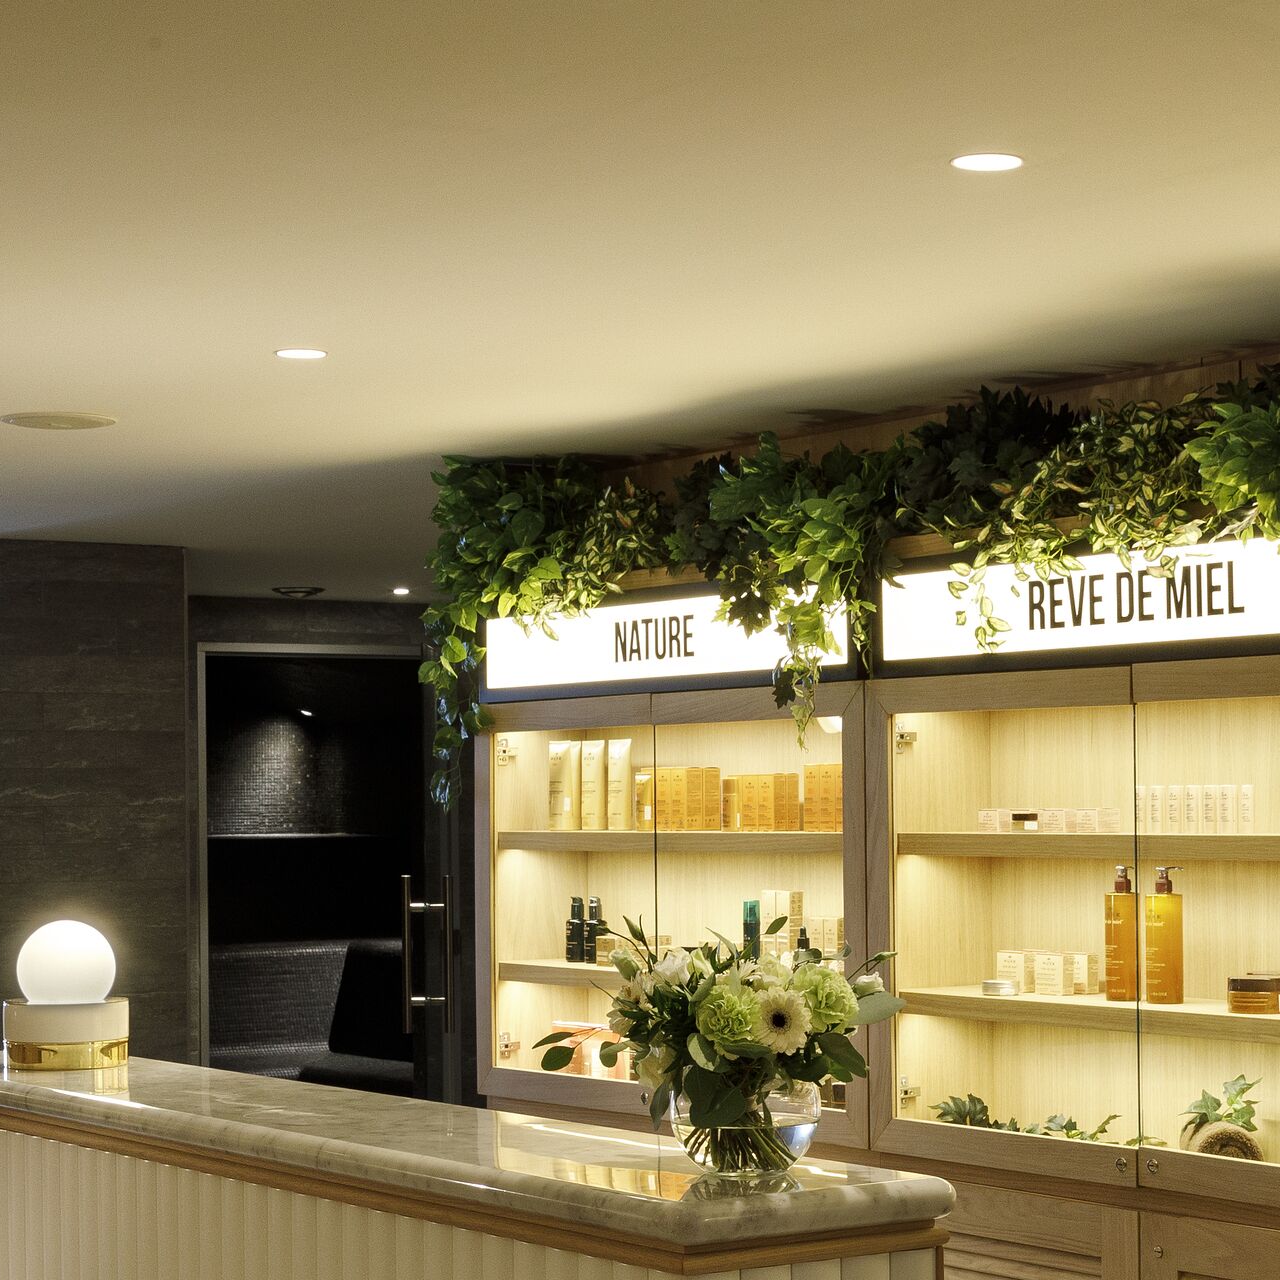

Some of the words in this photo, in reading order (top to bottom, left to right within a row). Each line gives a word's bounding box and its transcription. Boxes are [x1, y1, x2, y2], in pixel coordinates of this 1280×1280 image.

[1115, 570, 1155, 624] DE
[1165, 560, 1245, 620] MIEL
[614, 614, 695, 663] NATURE
